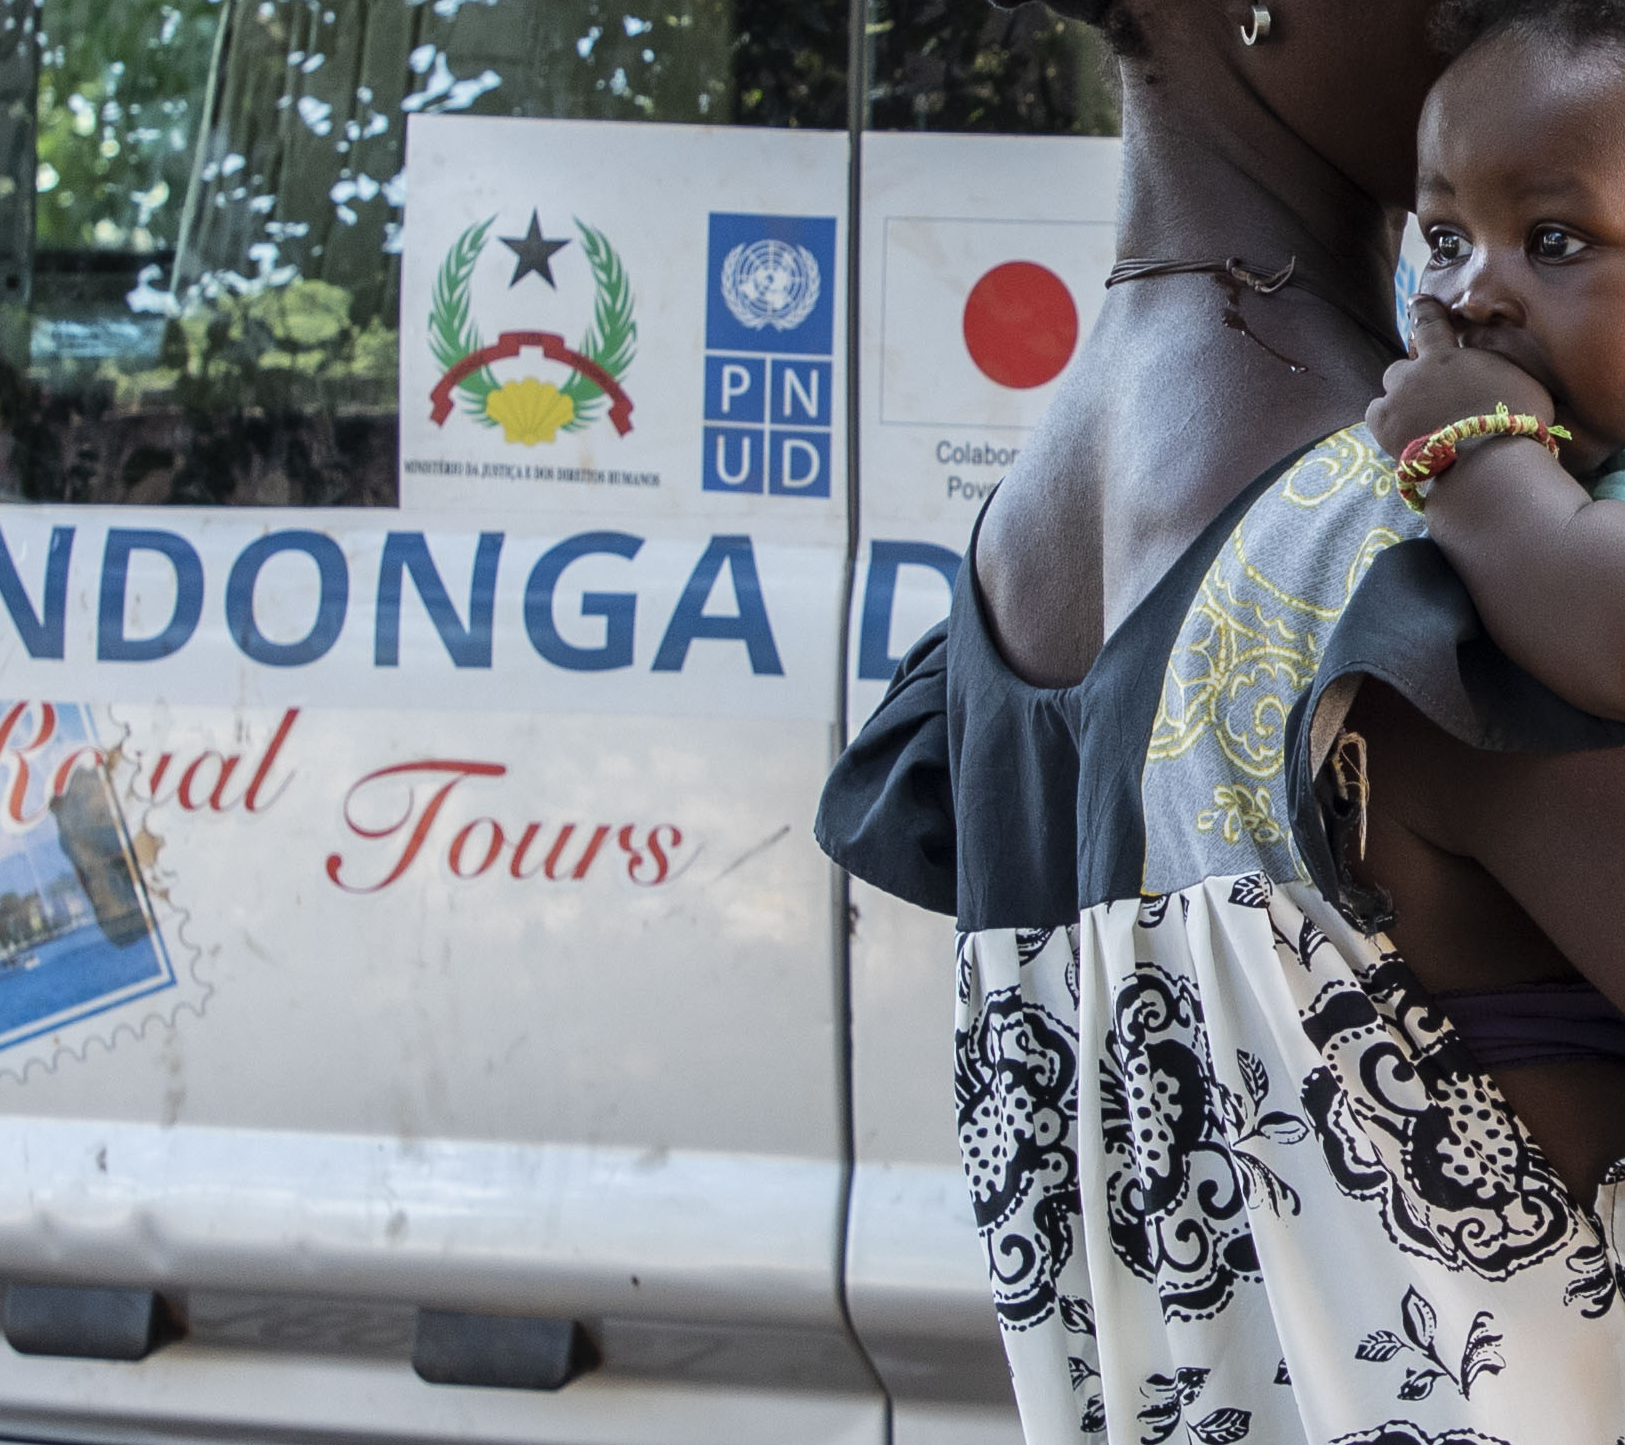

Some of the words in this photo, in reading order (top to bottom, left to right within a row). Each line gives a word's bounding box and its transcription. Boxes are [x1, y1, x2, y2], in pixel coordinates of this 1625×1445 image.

[936, 440, 1020, 466] Colabor
[857, 539, 963, 681] D
[326, 759, 706, 894] Tours
